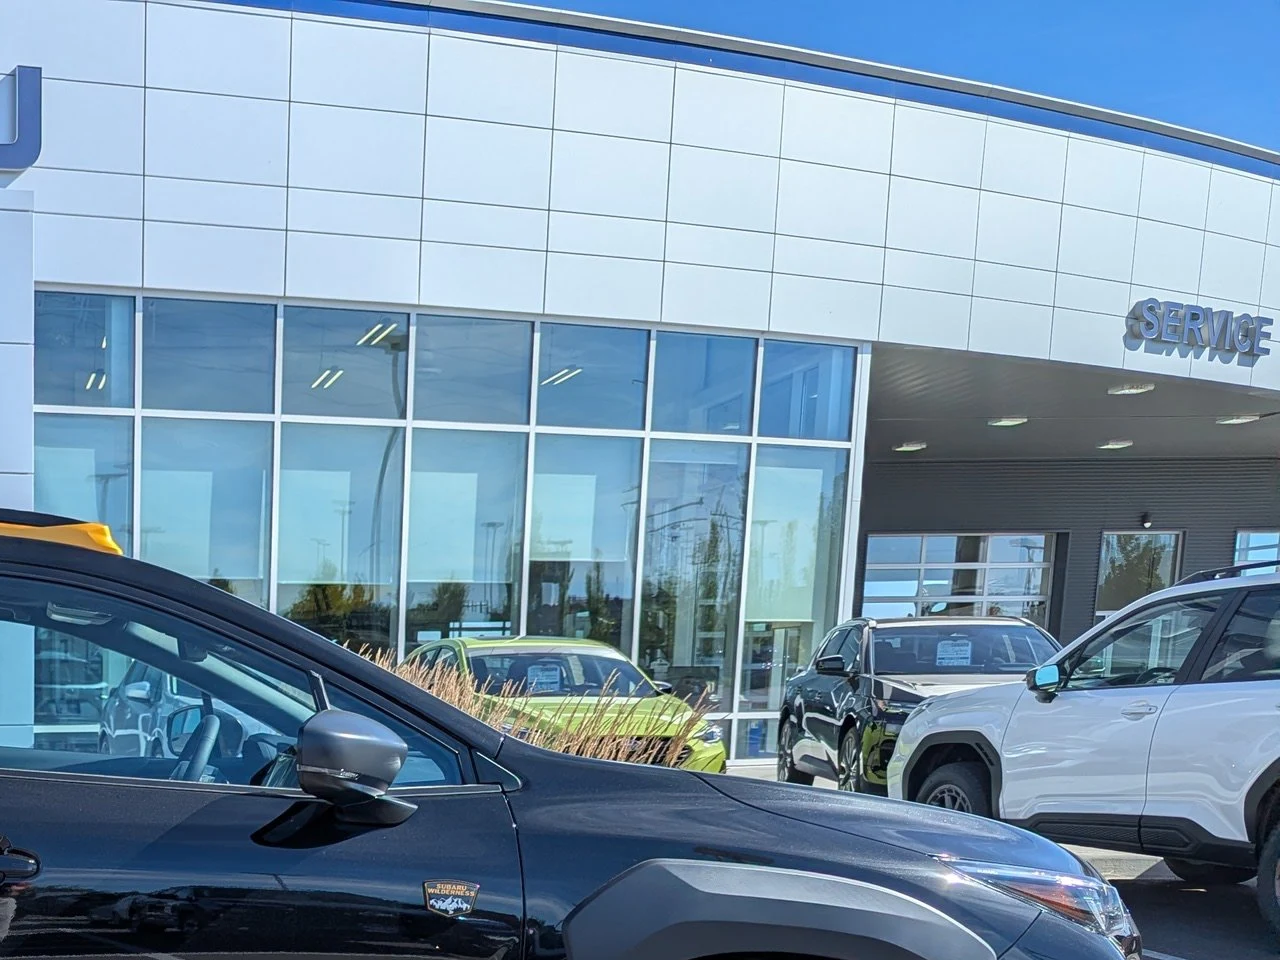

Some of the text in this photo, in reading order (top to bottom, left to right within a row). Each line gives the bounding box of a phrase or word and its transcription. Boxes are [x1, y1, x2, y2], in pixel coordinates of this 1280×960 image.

[1132, 298, 1274, 356] SERVICE
[436, 883, 468, 891] SUBARU
[427, 888, 475, 896] WILDERNESS
